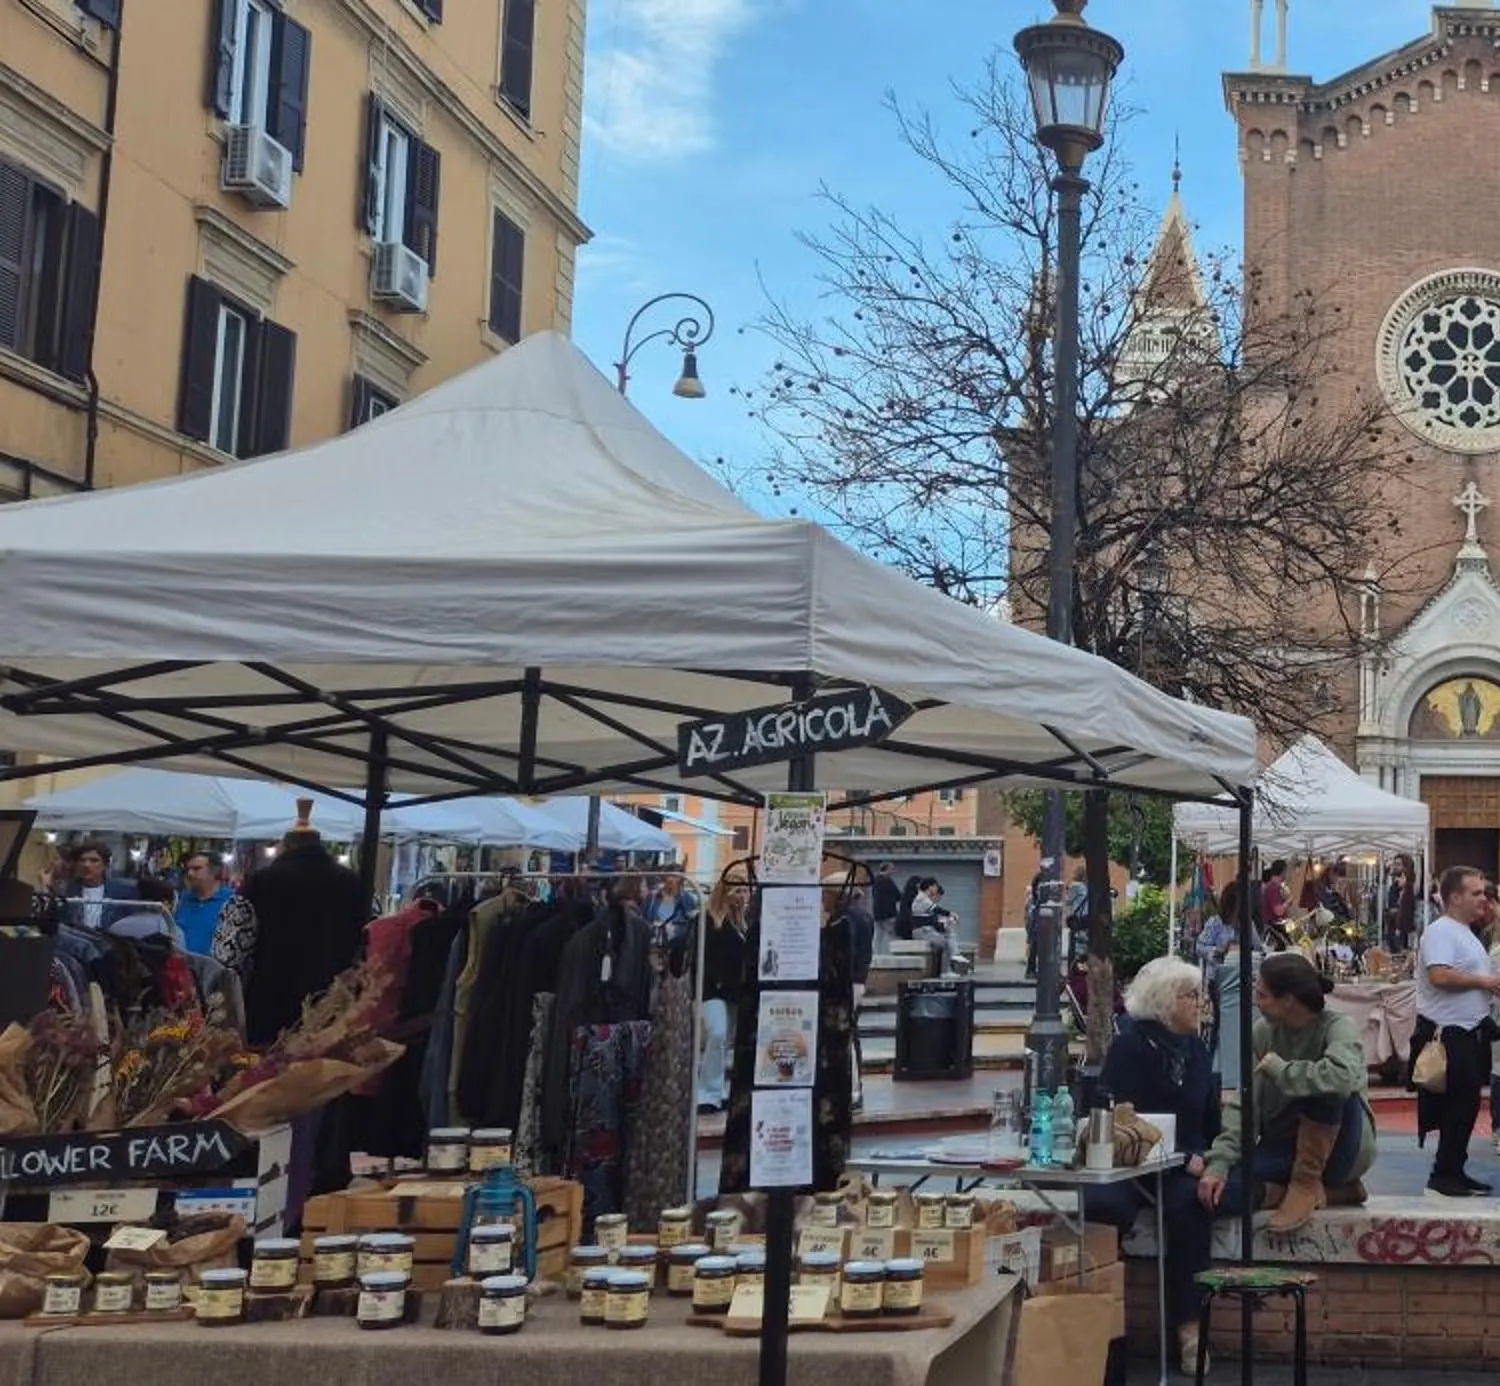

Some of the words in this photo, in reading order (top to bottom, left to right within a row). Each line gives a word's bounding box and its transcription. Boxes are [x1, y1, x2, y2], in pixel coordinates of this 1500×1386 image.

[741, 688, 893, 755] AGRICOLA
[0, 1144, 112, 1179] LOWER
[128, 1130, 232, 1168] FARM
[922, 1246, 939, 1258] 4€
